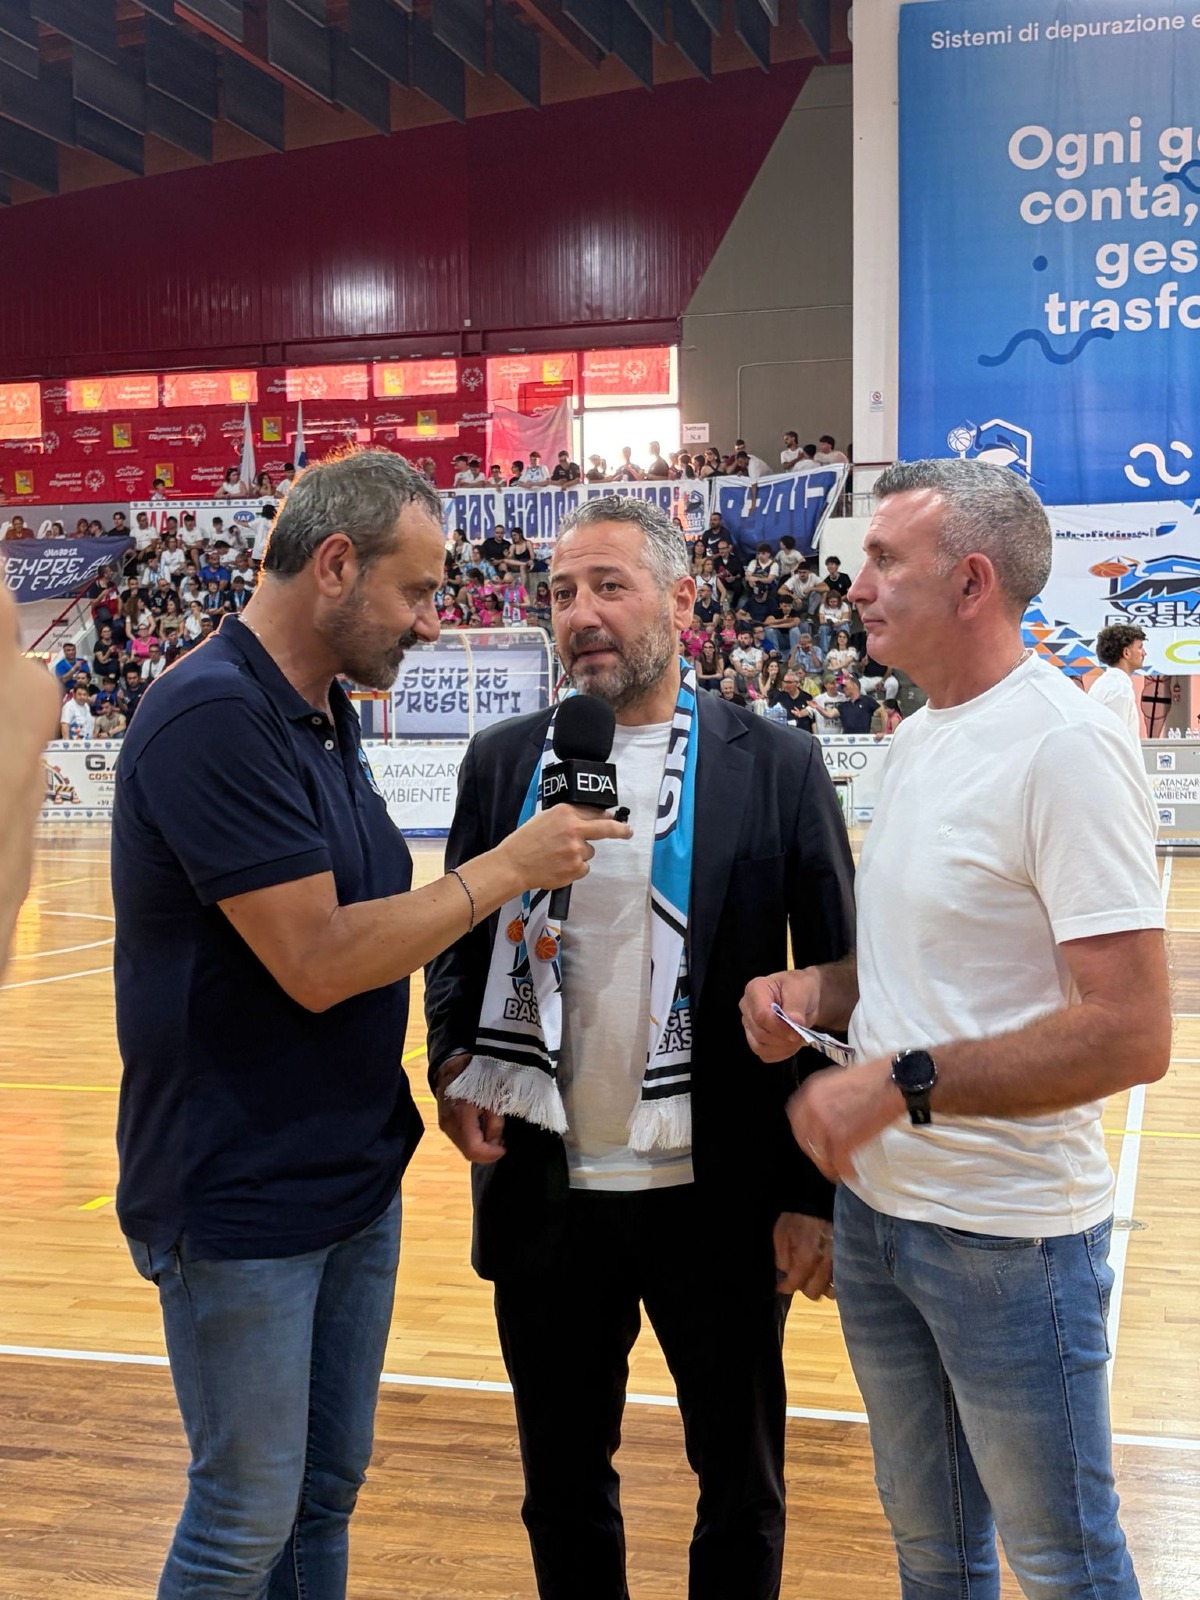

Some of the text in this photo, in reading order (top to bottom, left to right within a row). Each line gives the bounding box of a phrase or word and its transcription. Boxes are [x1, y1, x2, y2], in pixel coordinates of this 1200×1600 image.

[931, 25, 1012, 50] Sistemi
[1018, 22, 1039, 43] di
[1045, 14, 1185, 42] depurazione
[1008, 116, 1200, 180] Ogni g
[1020, 176, 1198, 227] conta,
[1095, 240, 1199, 289] ges
[4, 557, 84, 575] EMPRE
[403, 666, 508, 690] SEMPRE
[389, 690, 521, 714] PRESENTI
[383, 787, 451, 803] MBIENTE
